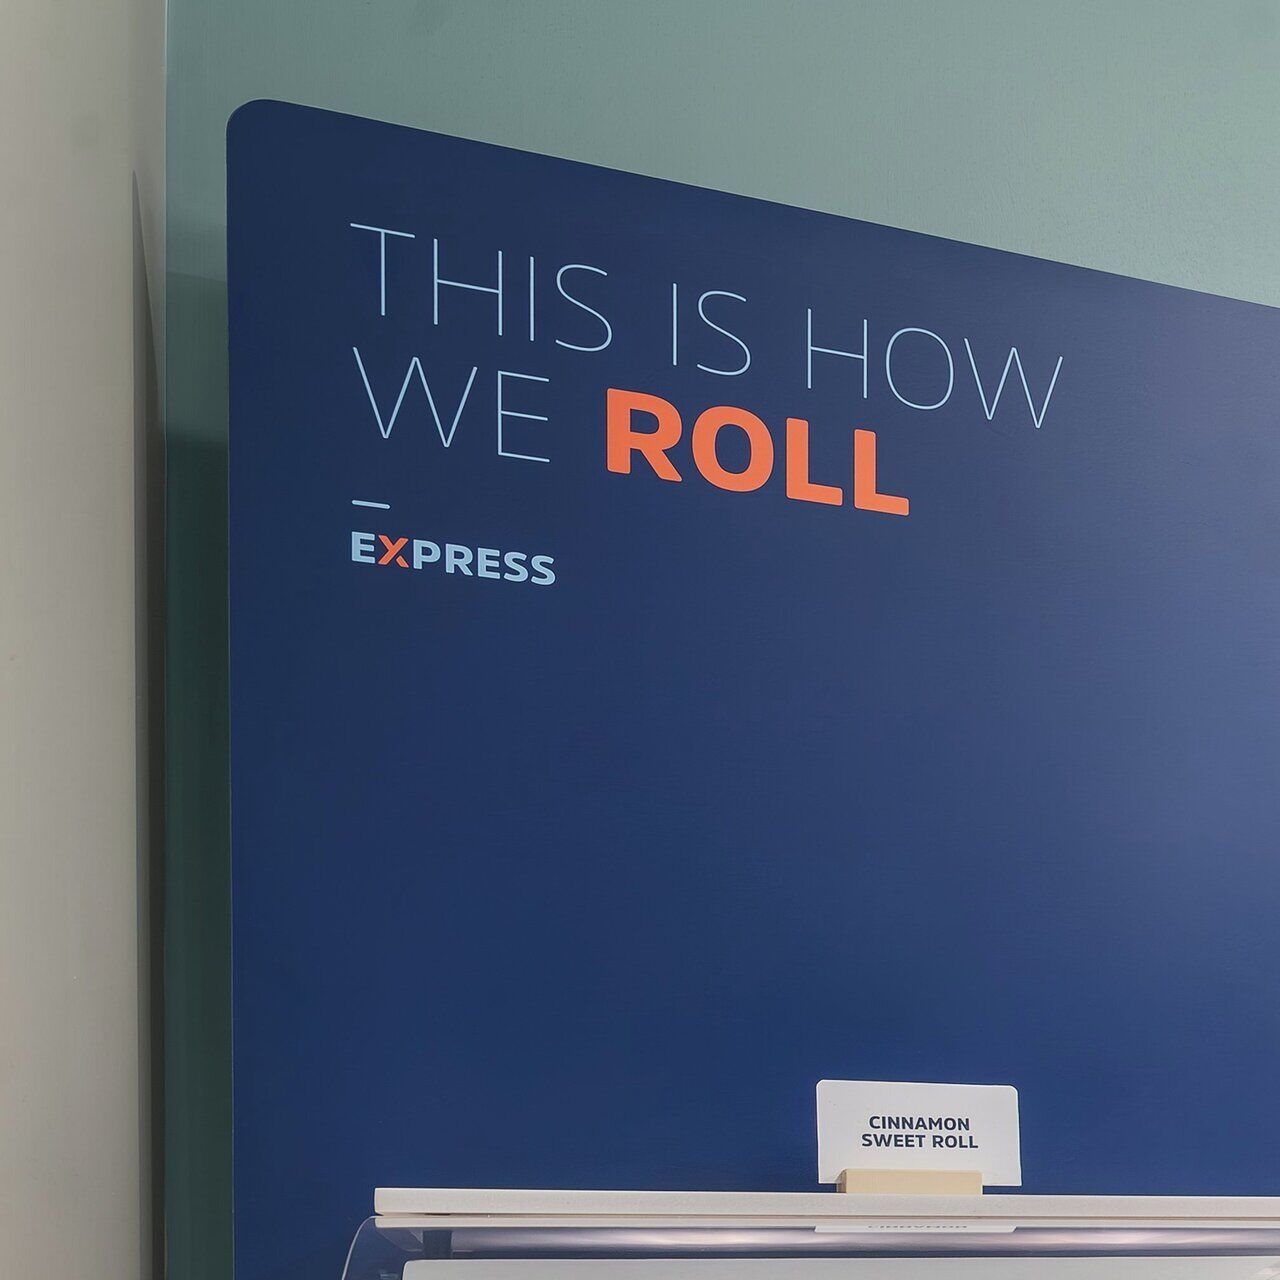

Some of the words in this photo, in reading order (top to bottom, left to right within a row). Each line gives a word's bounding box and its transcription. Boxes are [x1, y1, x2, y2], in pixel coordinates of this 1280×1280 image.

[350, 222, 612, 353] THIS
[672, 282, 751, 376] IS
[807, 308, 1063, 429] HOW
[352, 346, 550, 463] WE
[606, 387, 910, 516] ROLL
[351, 531, 555, 585] EXPRESS
[861, 1133, 926, 1148] SWEET
[932, 1134, 979, 1149] ROLL
[869, 1115, 970, 1131] CINNAMON
